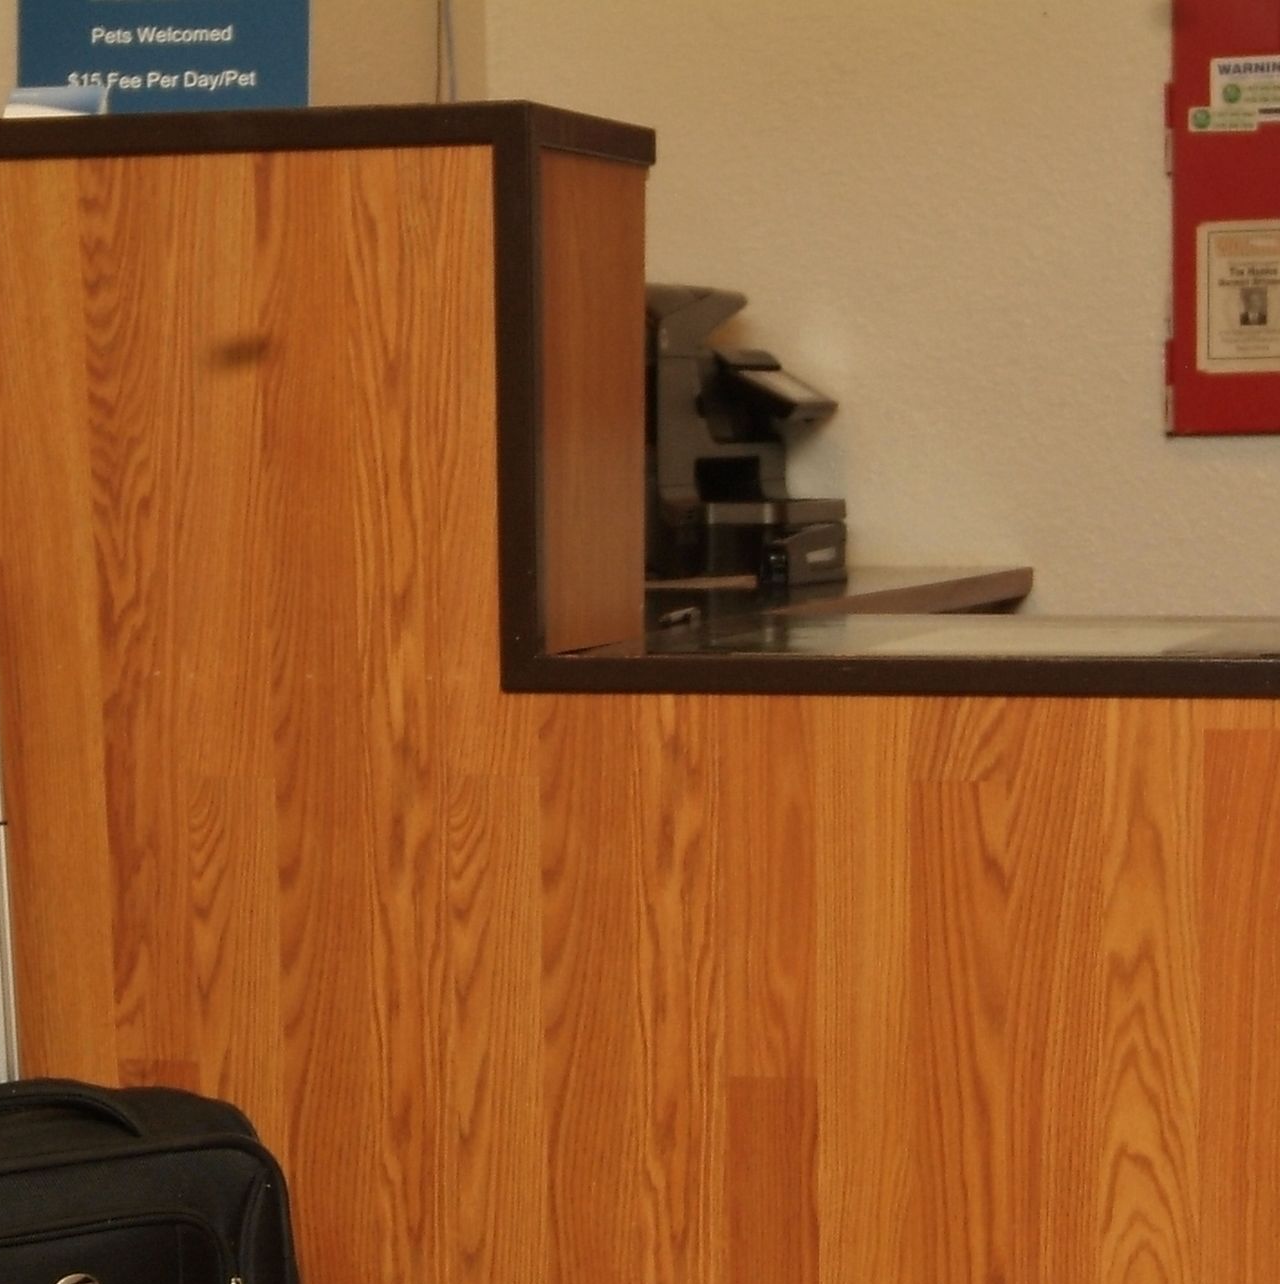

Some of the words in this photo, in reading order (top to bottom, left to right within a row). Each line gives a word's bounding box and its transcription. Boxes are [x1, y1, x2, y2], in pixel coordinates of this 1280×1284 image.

[91, 26, 132, 44] Pets
[137, 24, 234, 43] Welcomed
[107, 72, 142, 89] Fee
[147, 71, 179, 88] Per
[184, 70, 257, 91] Day/Pet
